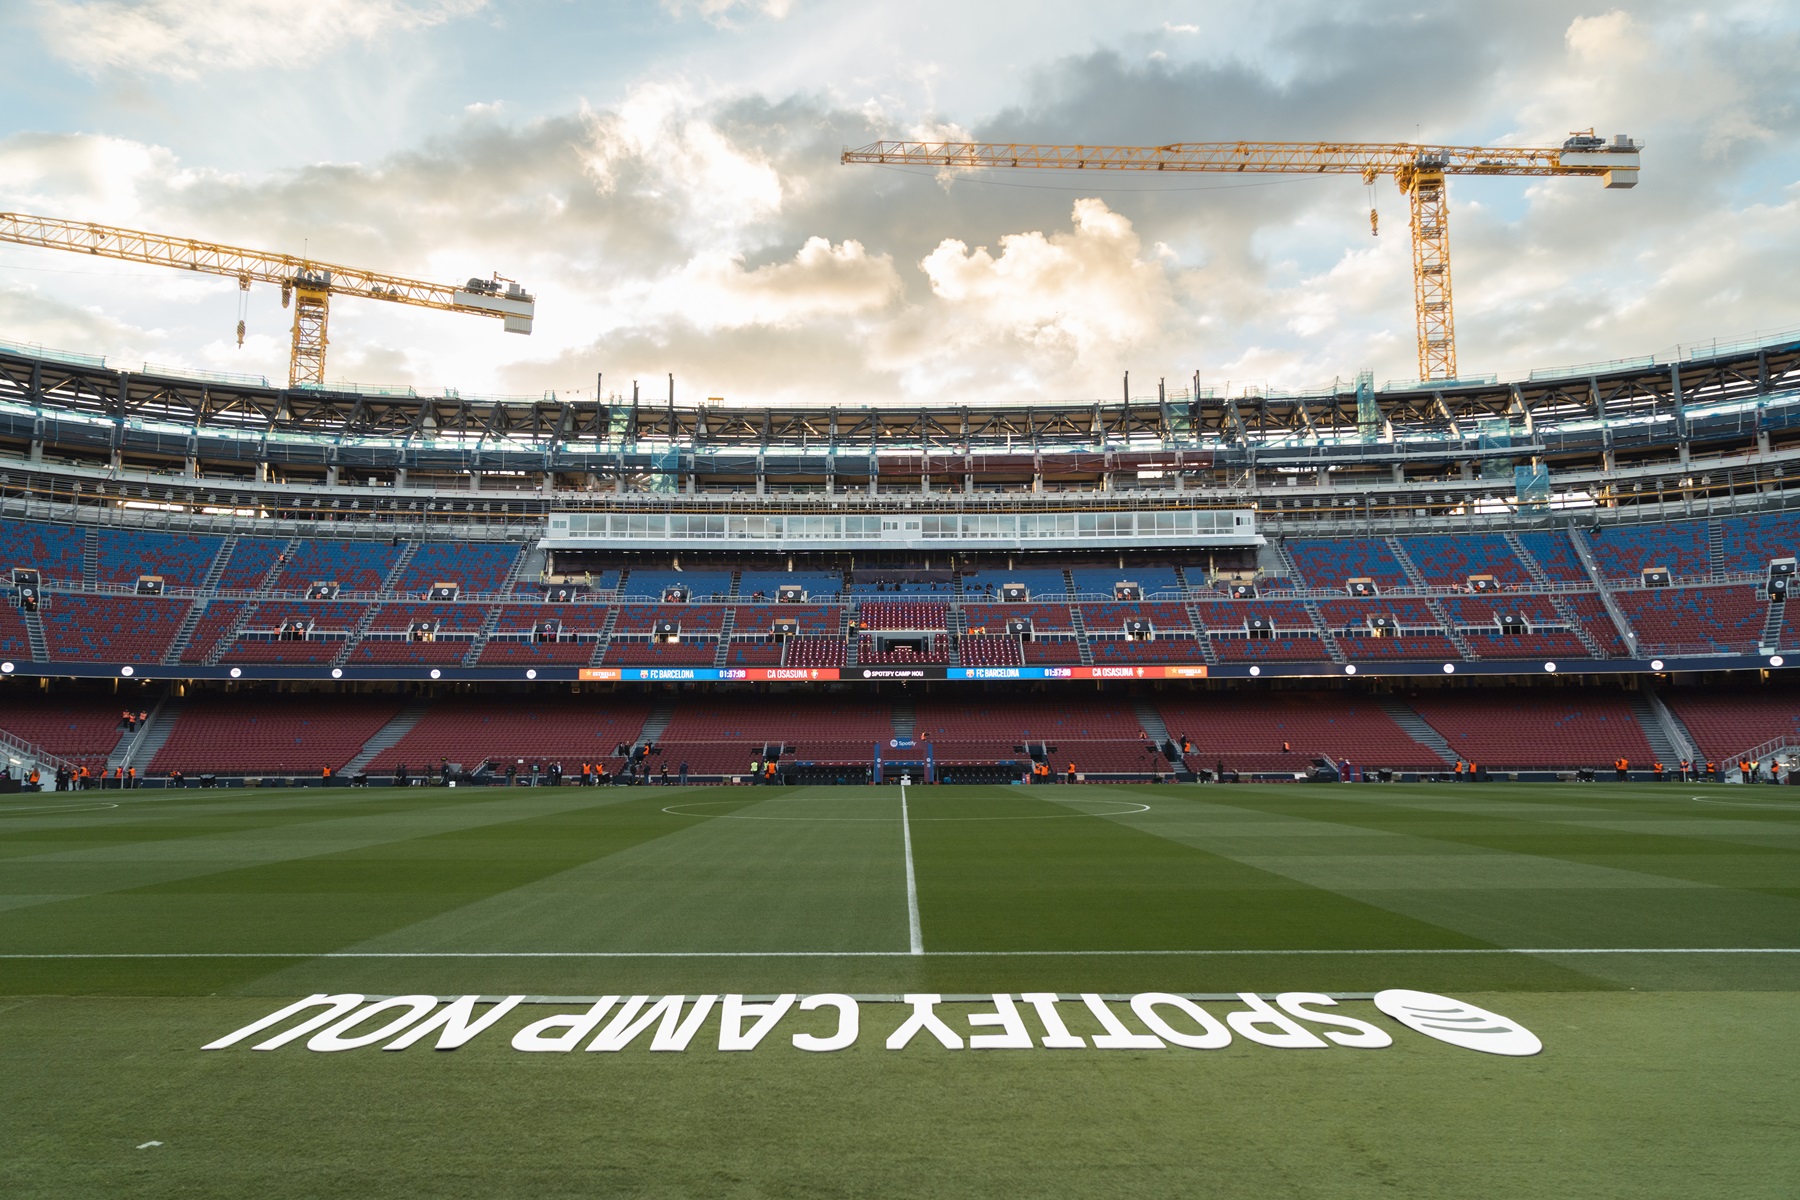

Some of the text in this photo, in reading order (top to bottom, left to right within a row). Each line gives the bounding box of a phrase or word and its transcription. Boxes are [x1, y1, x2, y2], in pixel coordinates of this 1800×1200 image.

[650, 669, 694, 678] FC BARCELONA
[767, 669, 808, 678] CA OSASUNA
[976, 668, 1020, 677] FC BARCELONA
[1092, 667, 1133, 676] CA OSASUNA
[200, 993, 1393, 1052] SPOTIFY CAMP NOU
